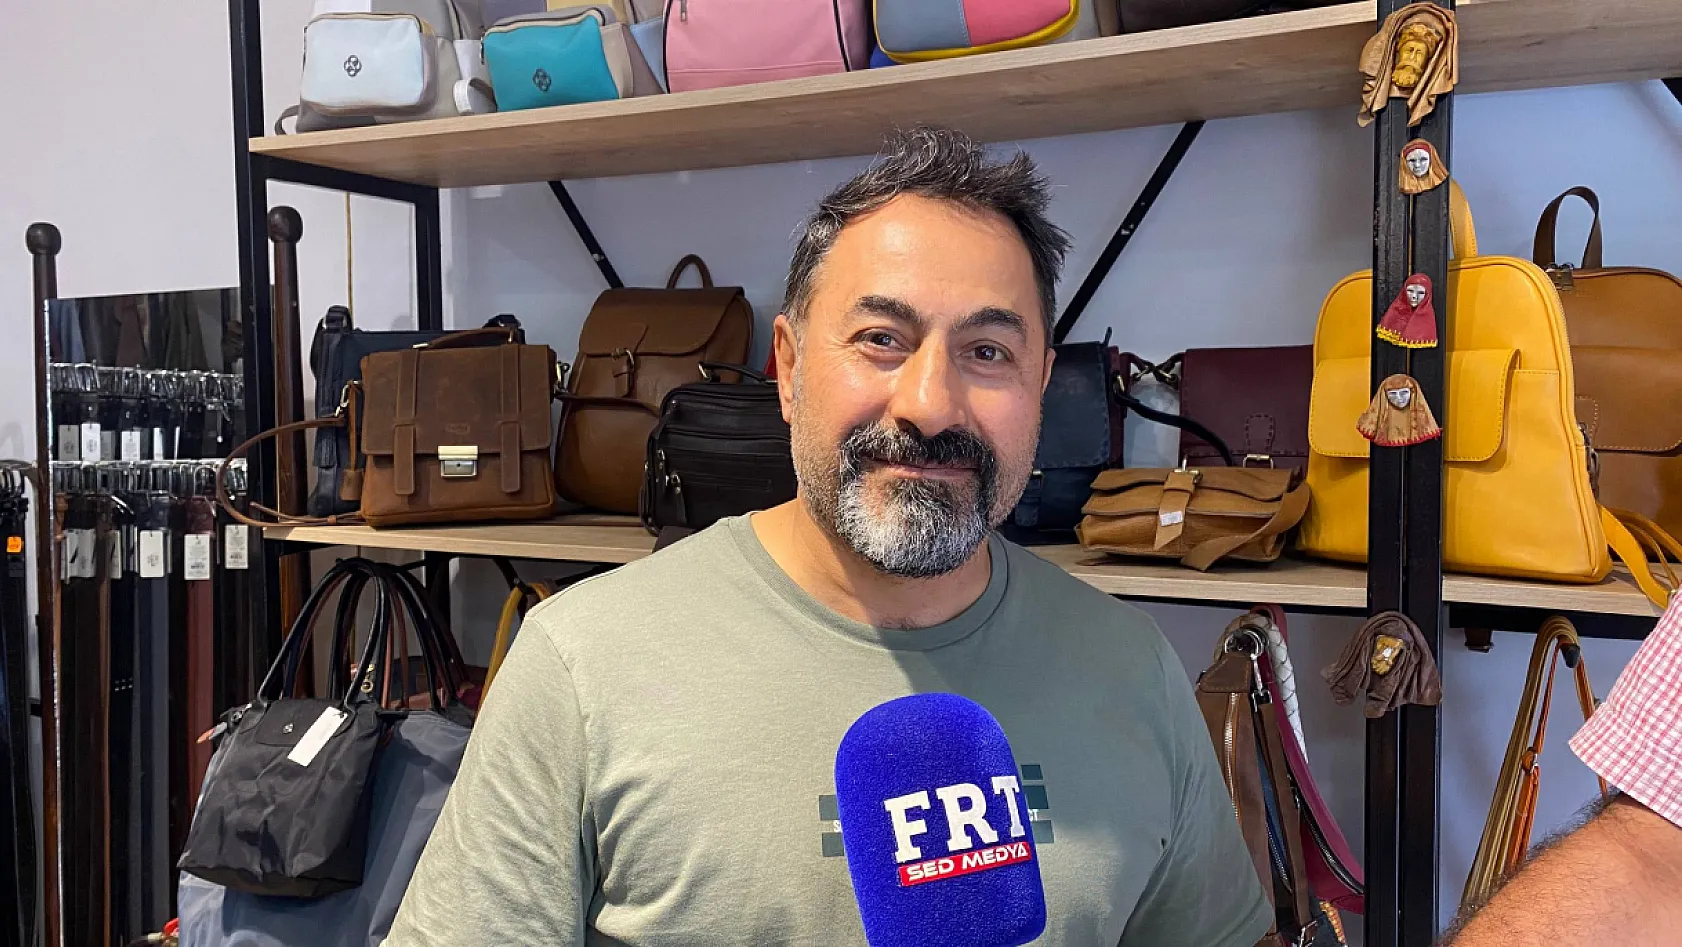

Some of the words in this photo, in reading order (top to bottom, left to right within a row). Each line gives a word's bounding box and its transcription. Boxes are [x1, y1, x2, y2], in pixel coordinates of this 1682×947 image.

[884, 776, 1026, 863] FRT
[907, 859, 954, 882] SED
[961, 844, 1029, 870] MEDYA
